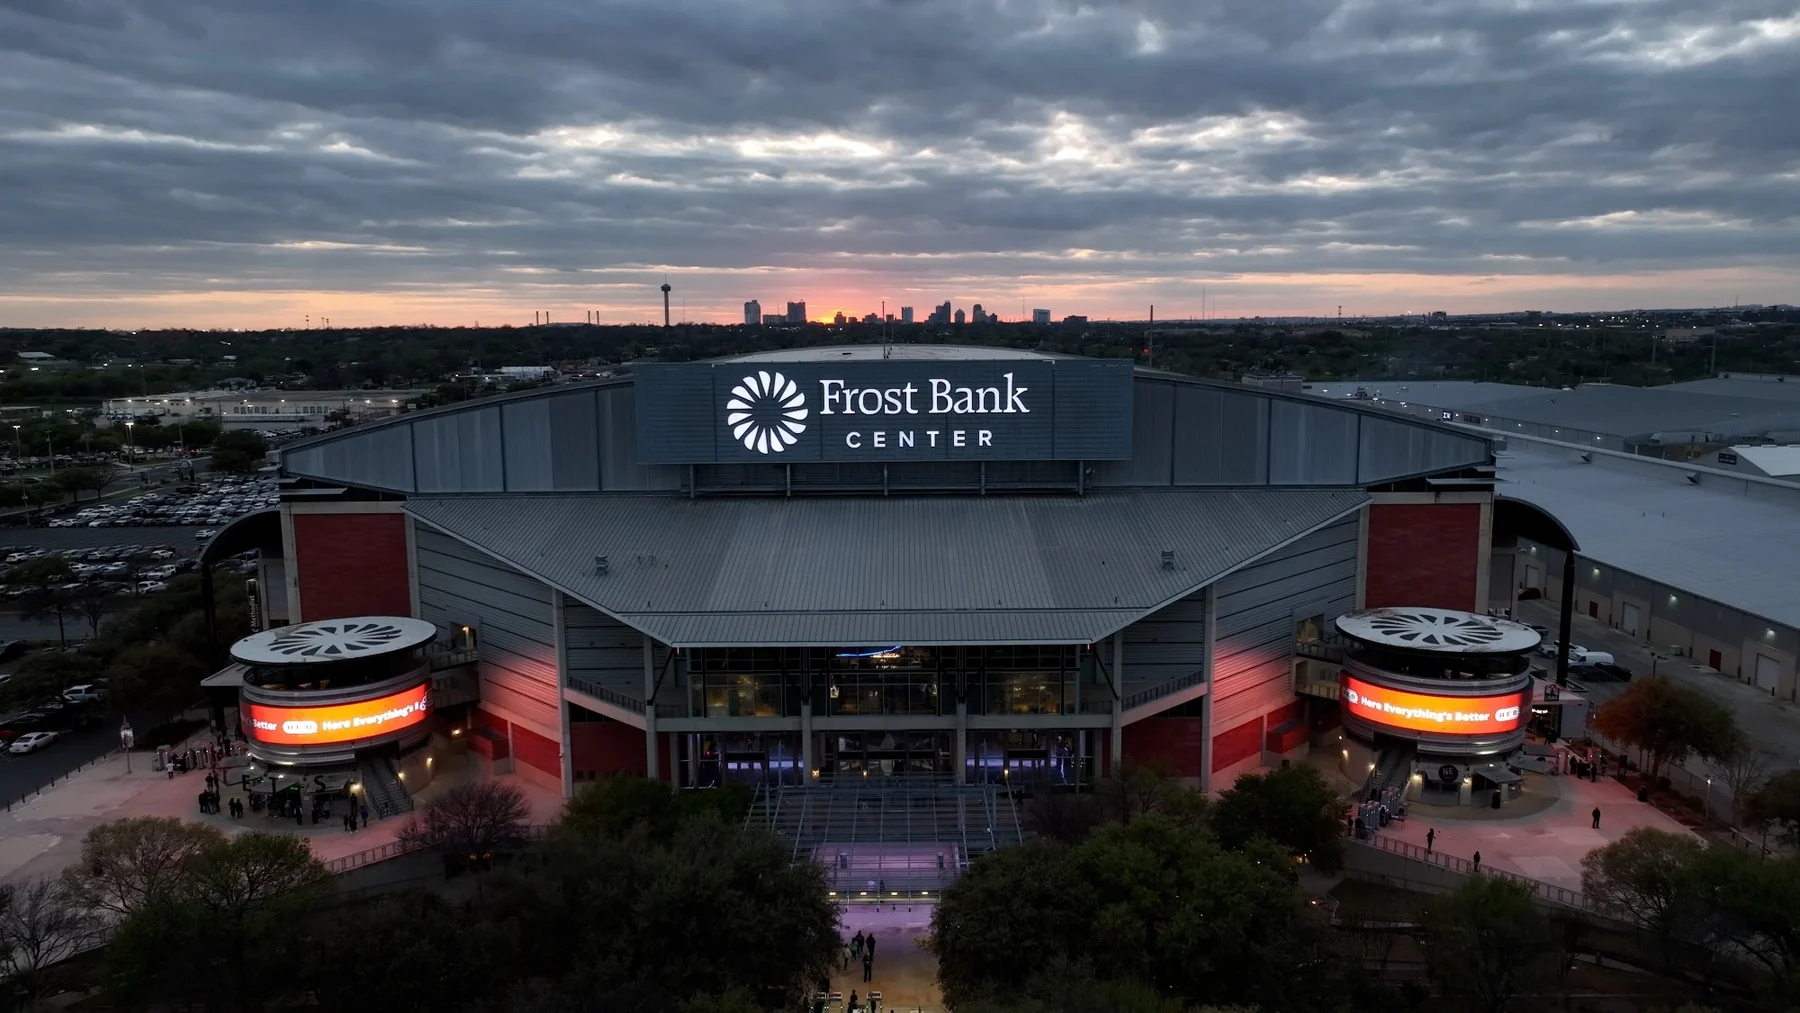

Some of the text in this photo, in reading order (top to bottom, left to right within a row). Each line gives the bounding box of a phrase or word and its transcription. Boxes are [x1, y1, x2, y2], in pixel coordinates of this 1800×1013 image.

[819, 372, 1031, 415] Frost Bank
[845, 429, 994, 449] CENTER
[249, 595, 257, 627] Methodist
[321, 719, 352, 731] Here
[352, 704, 414, 727] Everything's
[1361, 696, 1382, 711] Here
[1383, 702, 1453, 723] Everything's
[1454, 711, 1491, 722] Better
[1442, 767, 1454, 775] NE
